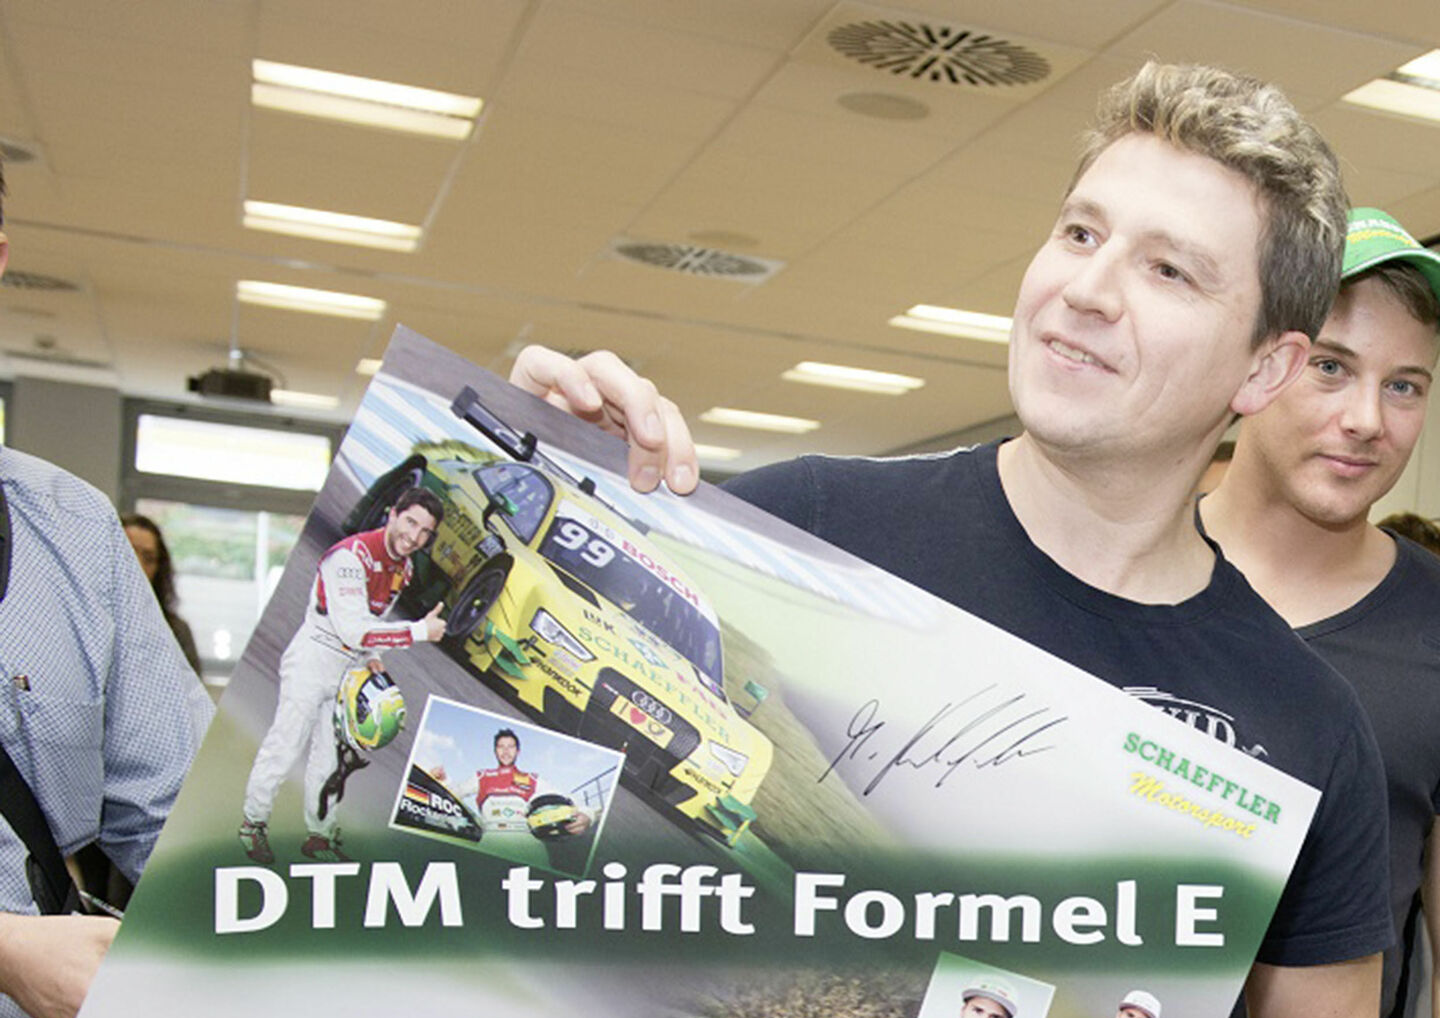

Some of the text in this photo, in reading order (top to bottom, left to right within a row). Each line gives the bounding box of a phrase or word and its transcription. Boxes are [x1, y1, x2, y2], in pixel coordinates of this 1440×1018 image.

[552, 521, 616, 568] 99
[622, 540, 699, 606] BOSCH
[1122, 732, 1282, 825] SCHAEFFLER
[1130, 771, 1257, 839] Motorsport
[215, 862, 1225, 947] DTM trifft Formel E
